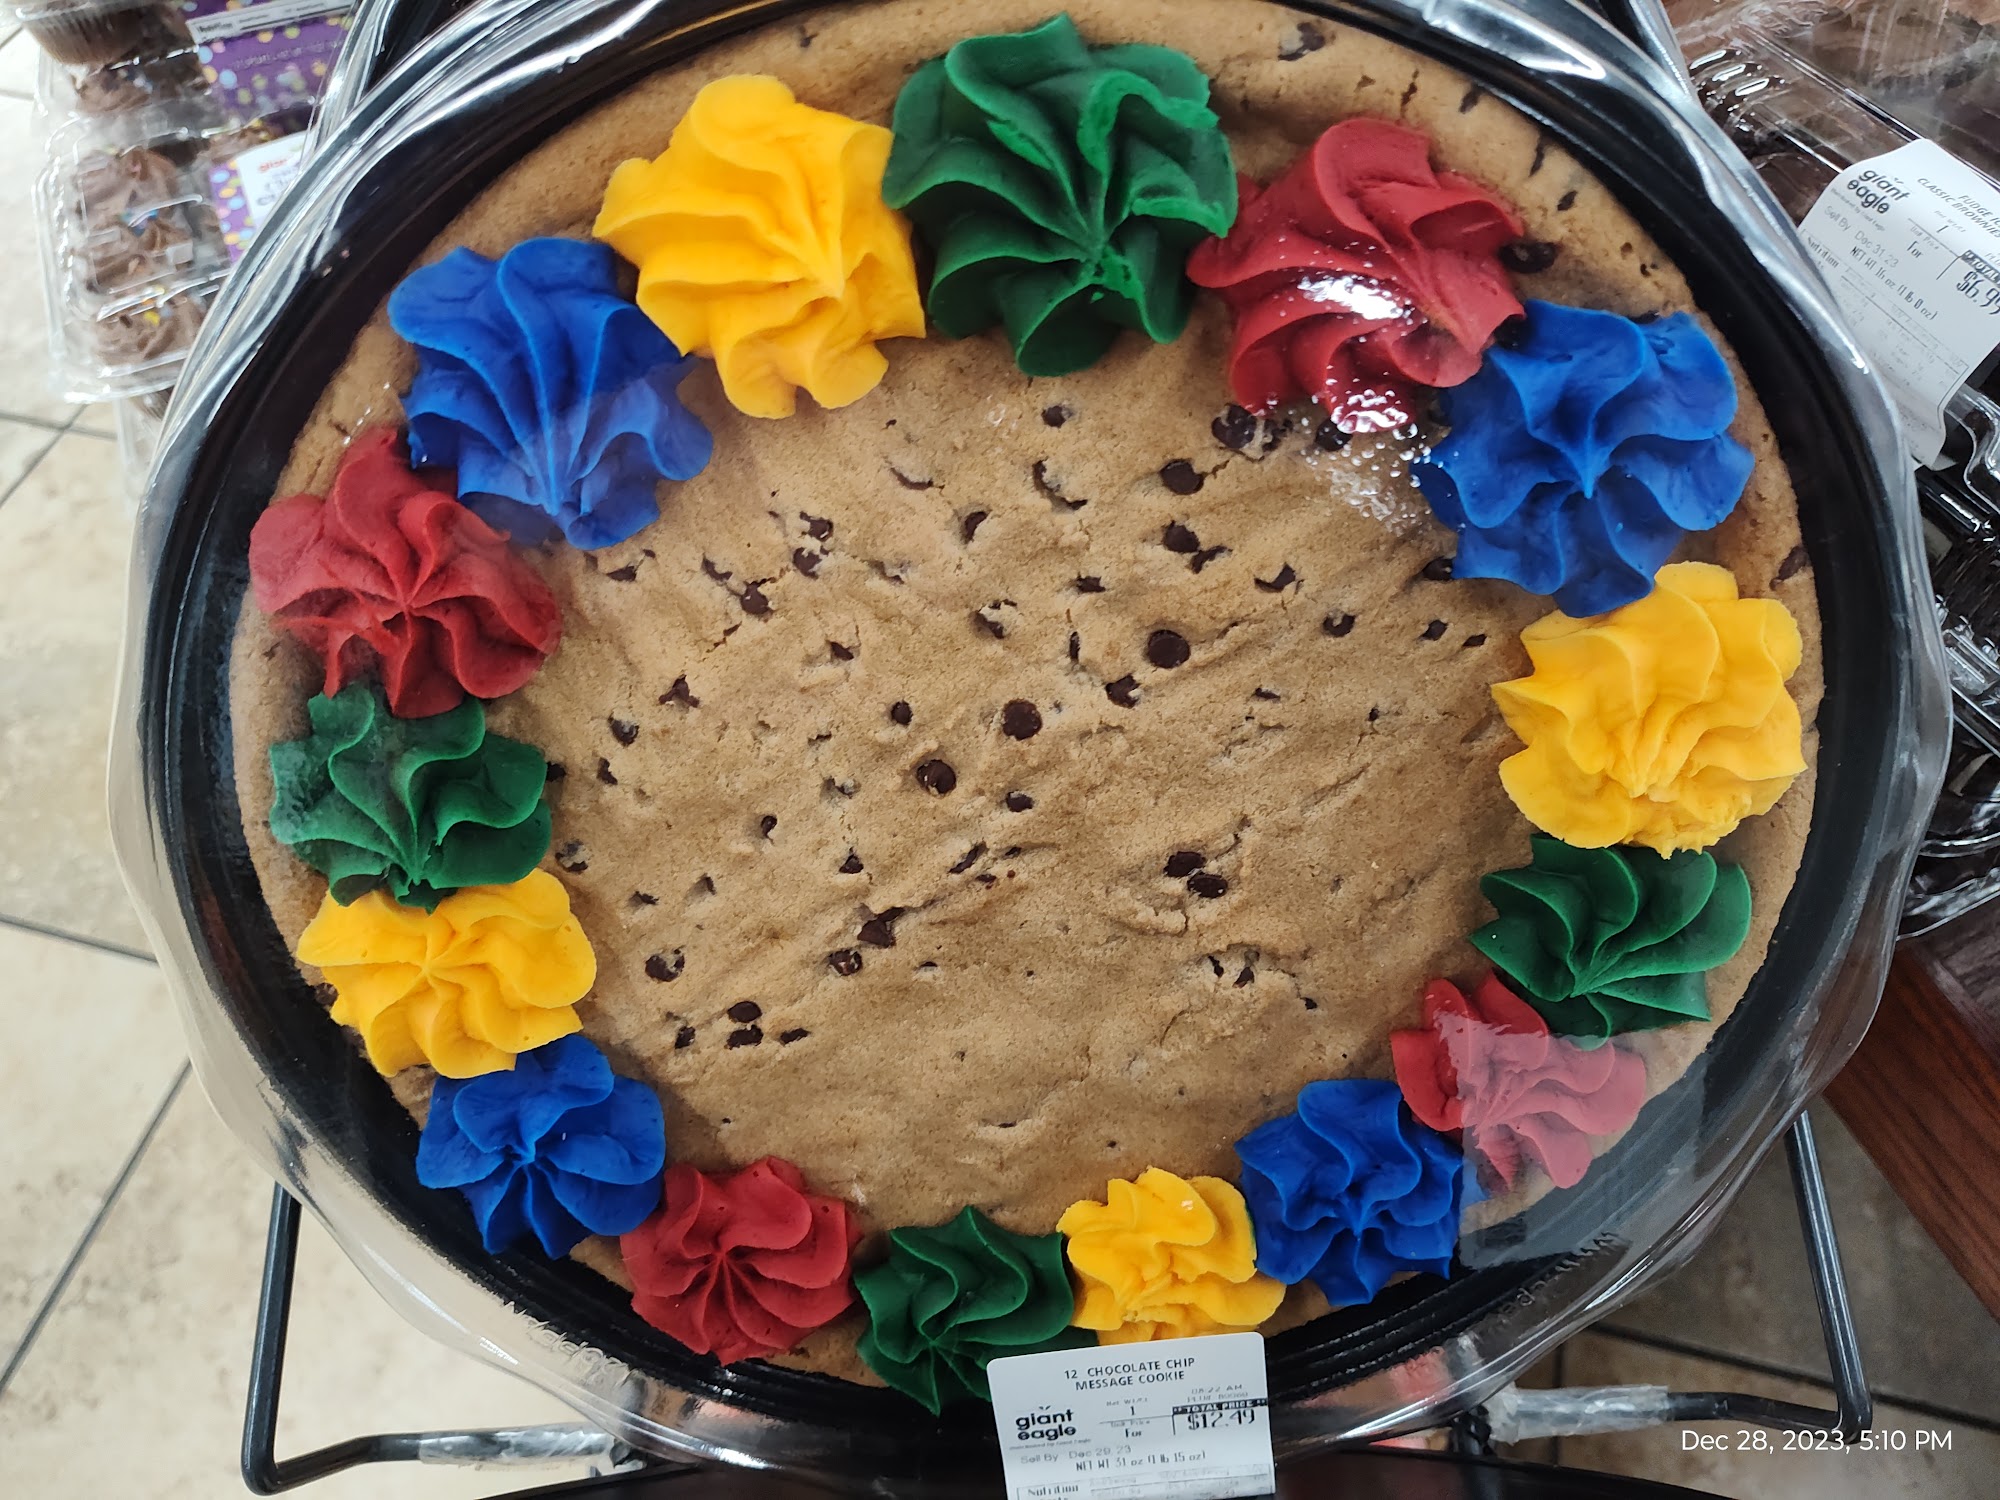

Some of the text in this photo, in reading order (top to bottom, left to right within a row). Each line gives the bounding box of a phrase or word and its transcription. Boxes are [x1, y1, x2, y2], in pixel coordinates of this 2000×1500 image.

[1847, 179, 1890, 214] eagle
[1858, 169, 1911, 201] giant
[1917, 177, 1956, 204] CLASSIC
[1957, 194, 1994, 218] FUDGE
[1971, 257, 1999, 281] TOTAL
[1884, 278, 1896, 289] oz
[1920, 307, 1938, 321] oz)
[1064, 1357, 1195, 1380] 12 CHOCOLATE CHIP
[1075, 1370, 1185, 1391] MESSAGE COOKIE
[1130, 1405, 1136, 1416] 1
[1186, 1402, 1219, 1413] TOTAL
[1221, 1399, 1254, 1410] PRICE
[1015, 1407, 1074, 1430] giant
[1187, 1408, 1255, 1430] $12.49
[1017, 1424, 1076, 1441] eagle
[1044, 1453, 1059, 1463] By
[1068, 1450, 1092, 1459] Dec
